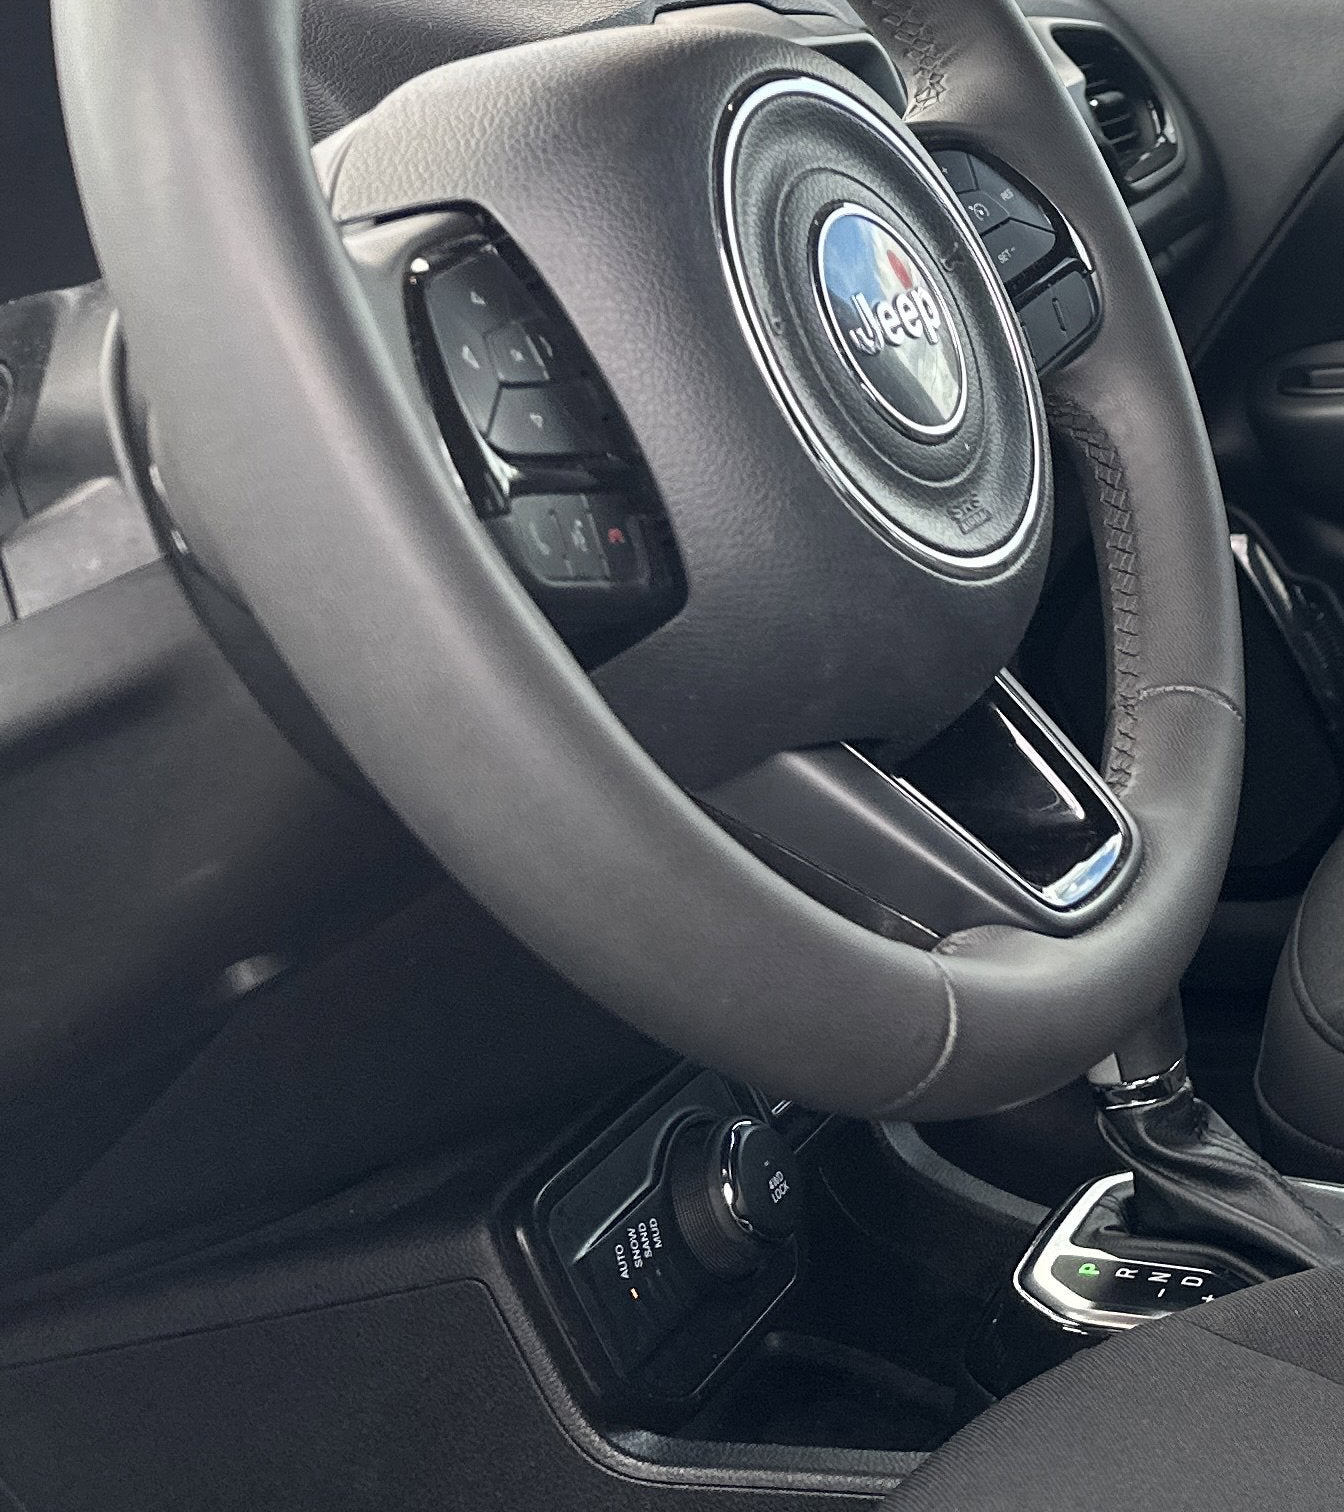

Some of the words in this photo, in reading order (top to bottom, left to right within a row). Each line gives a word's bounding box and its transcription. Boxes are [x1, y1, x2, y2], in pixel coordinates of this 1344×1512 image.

[997, 248, 1013, 264] SET
[849, 287, 941, 355] Jeep
[768, 1171, 784, 1190] 4WD
[772, 1180, 790, 1204] LOCK
[638, 1222, 652, 1258] SAND
[649, 1218, 662, 1248] MUD
[627, 1228, 642, 1268] SNOW
[614, 1244, 629, 1279] AUTO
[1079, 1263, 1100, 1276] P
[1115, 1268, 1138, 1279] R
[1148, 1272, 1171, 1283] N
[1181, 1276, 1203, 1287] D
